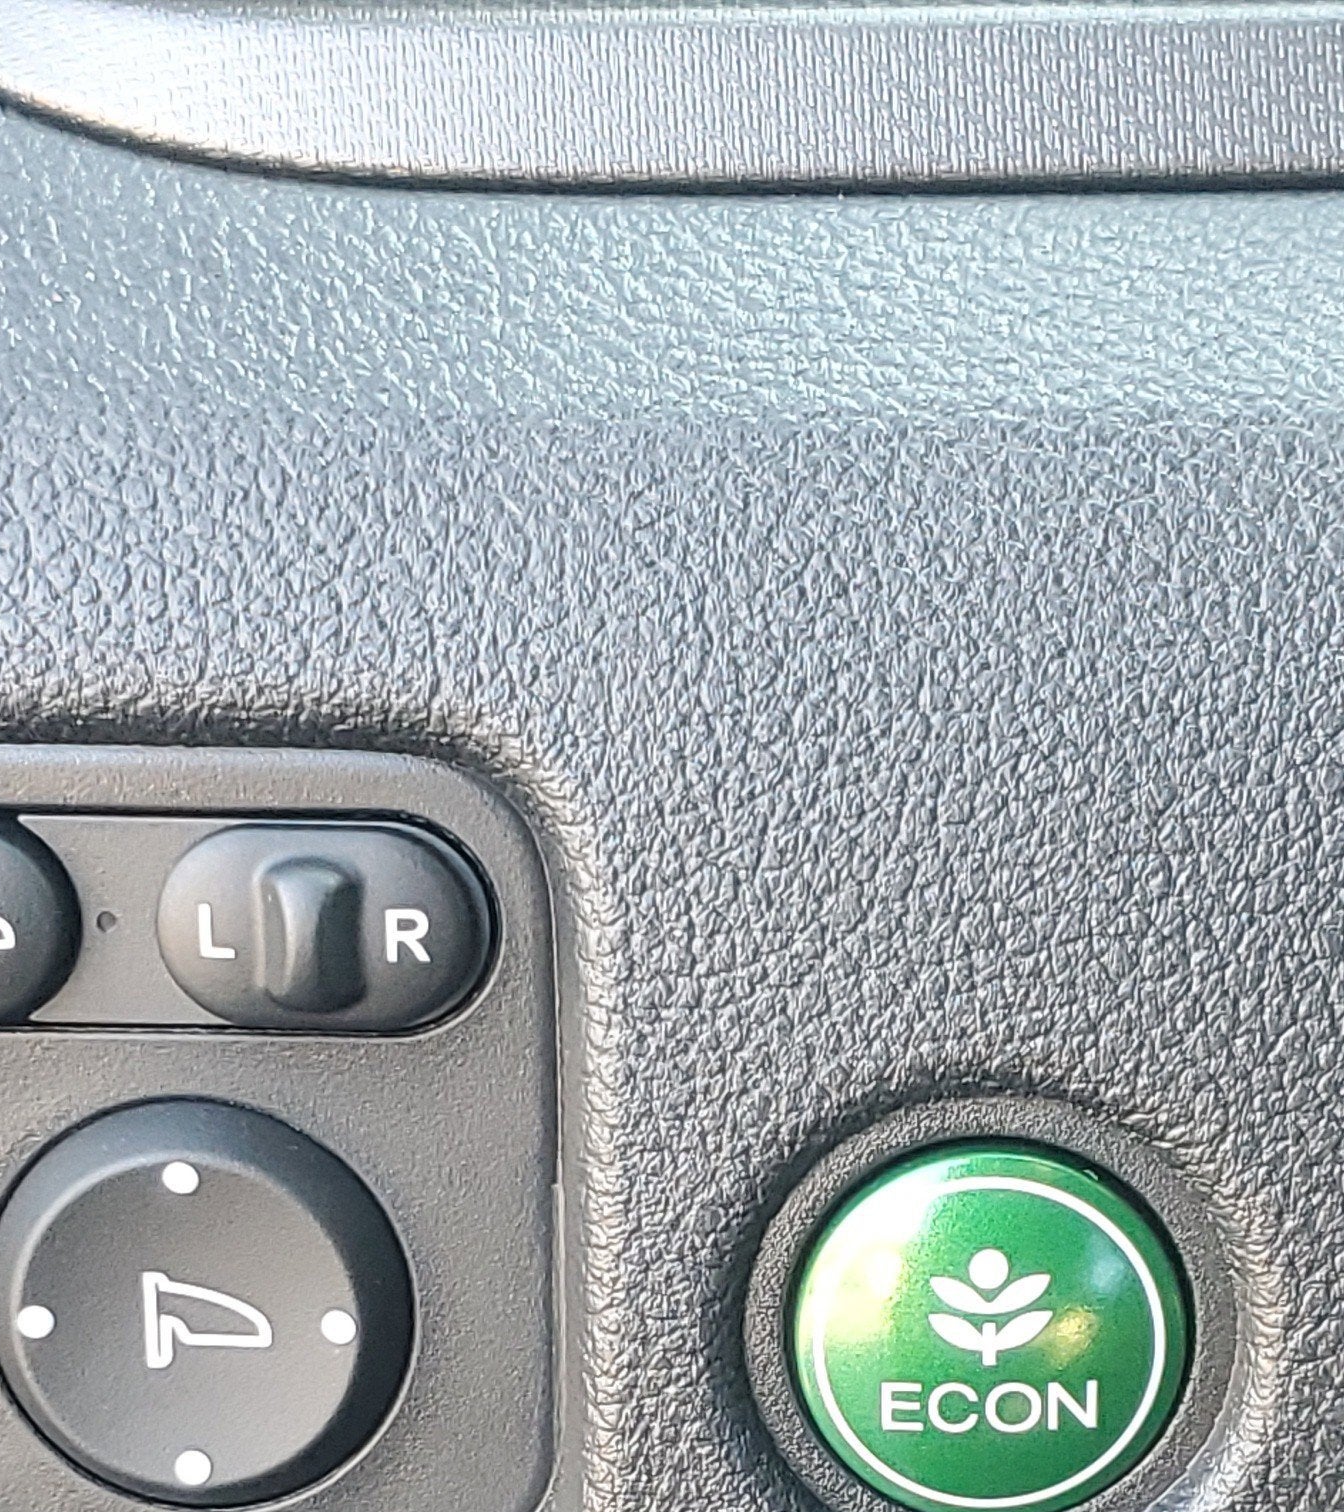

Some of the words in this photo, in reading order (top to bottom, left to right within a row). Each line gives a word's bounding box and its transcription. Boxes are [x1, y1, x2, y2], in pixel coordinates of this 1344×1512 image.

[197, 903, 236, 960] L
[384, 908, 431, 964] R
[879, 1379, 1099, 1434] ECON
